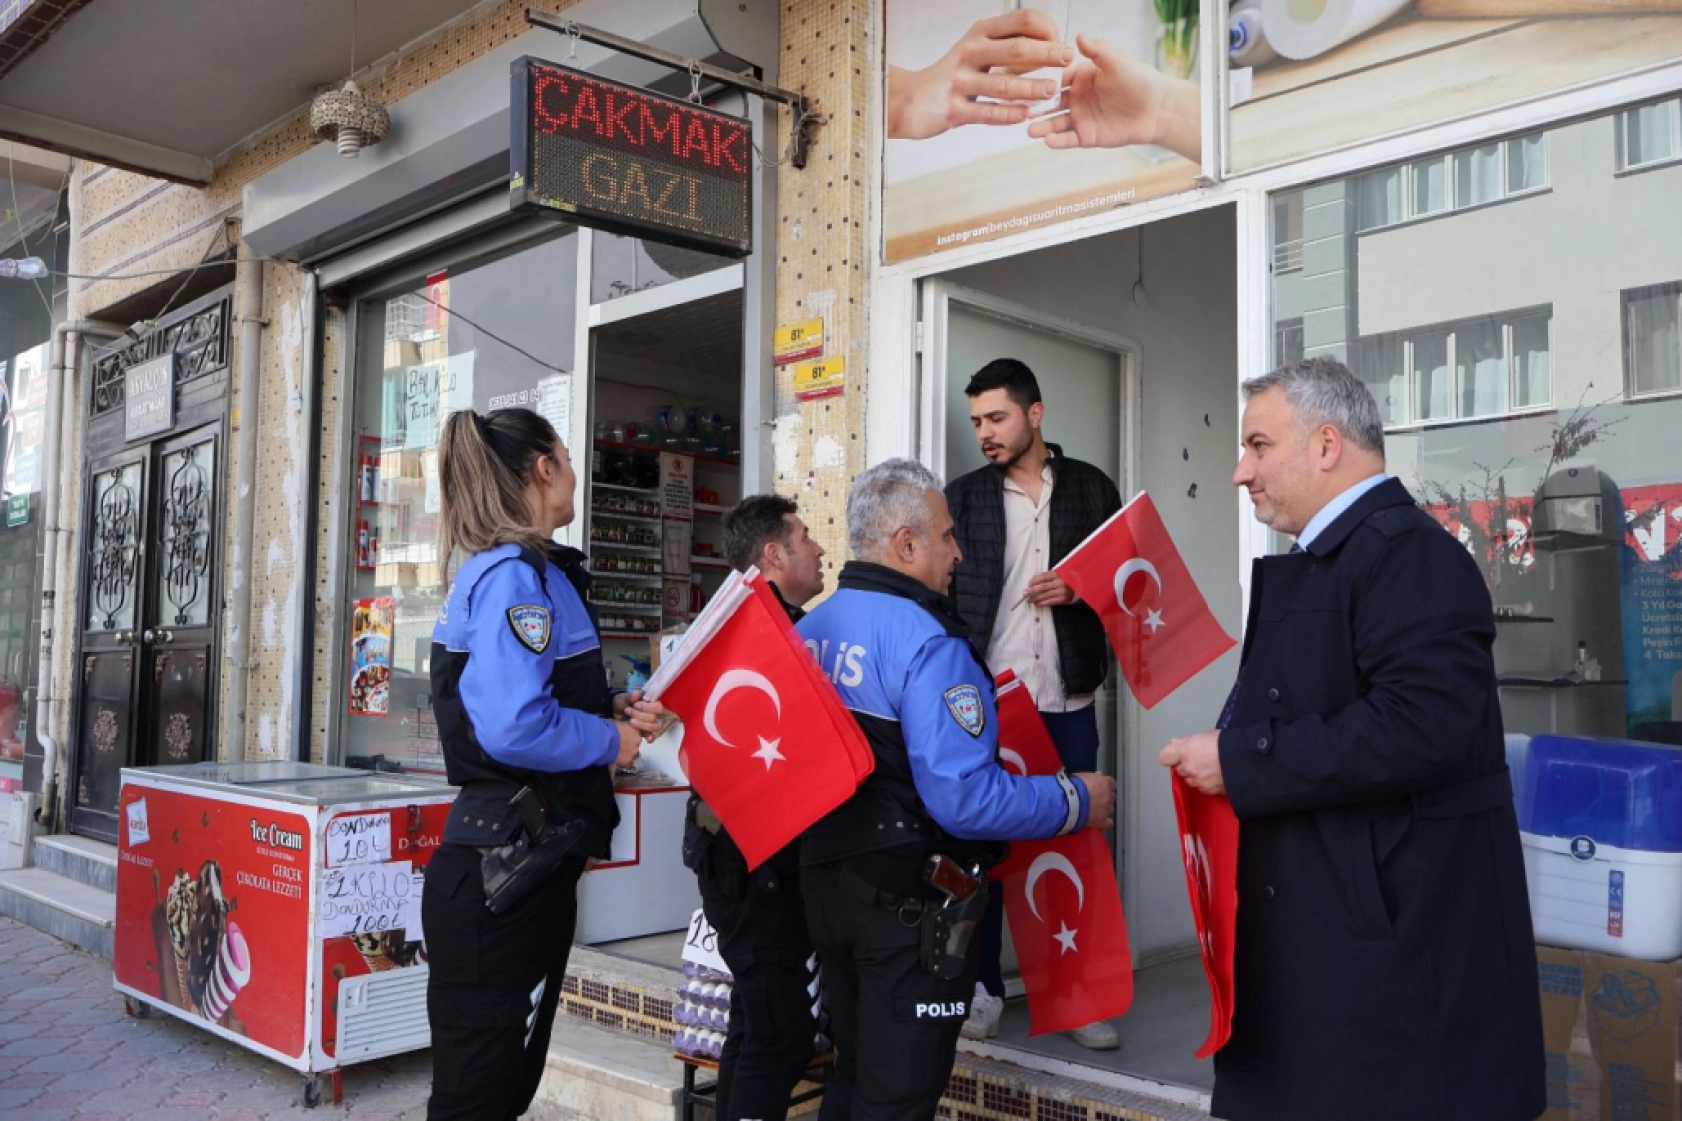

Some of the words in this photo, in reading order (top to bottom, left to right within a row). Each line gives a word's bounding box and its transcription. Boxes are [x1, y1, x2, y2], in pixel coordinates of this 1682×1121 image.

[535, 76, 742, 173] ÇAKMAK
[582, 153, 701, 221] GAZI
[1642, 625, 1671, 635] Kredi
[269, 823, 303, 851] Cream
[398, 834, 442, 850] DĞAL
